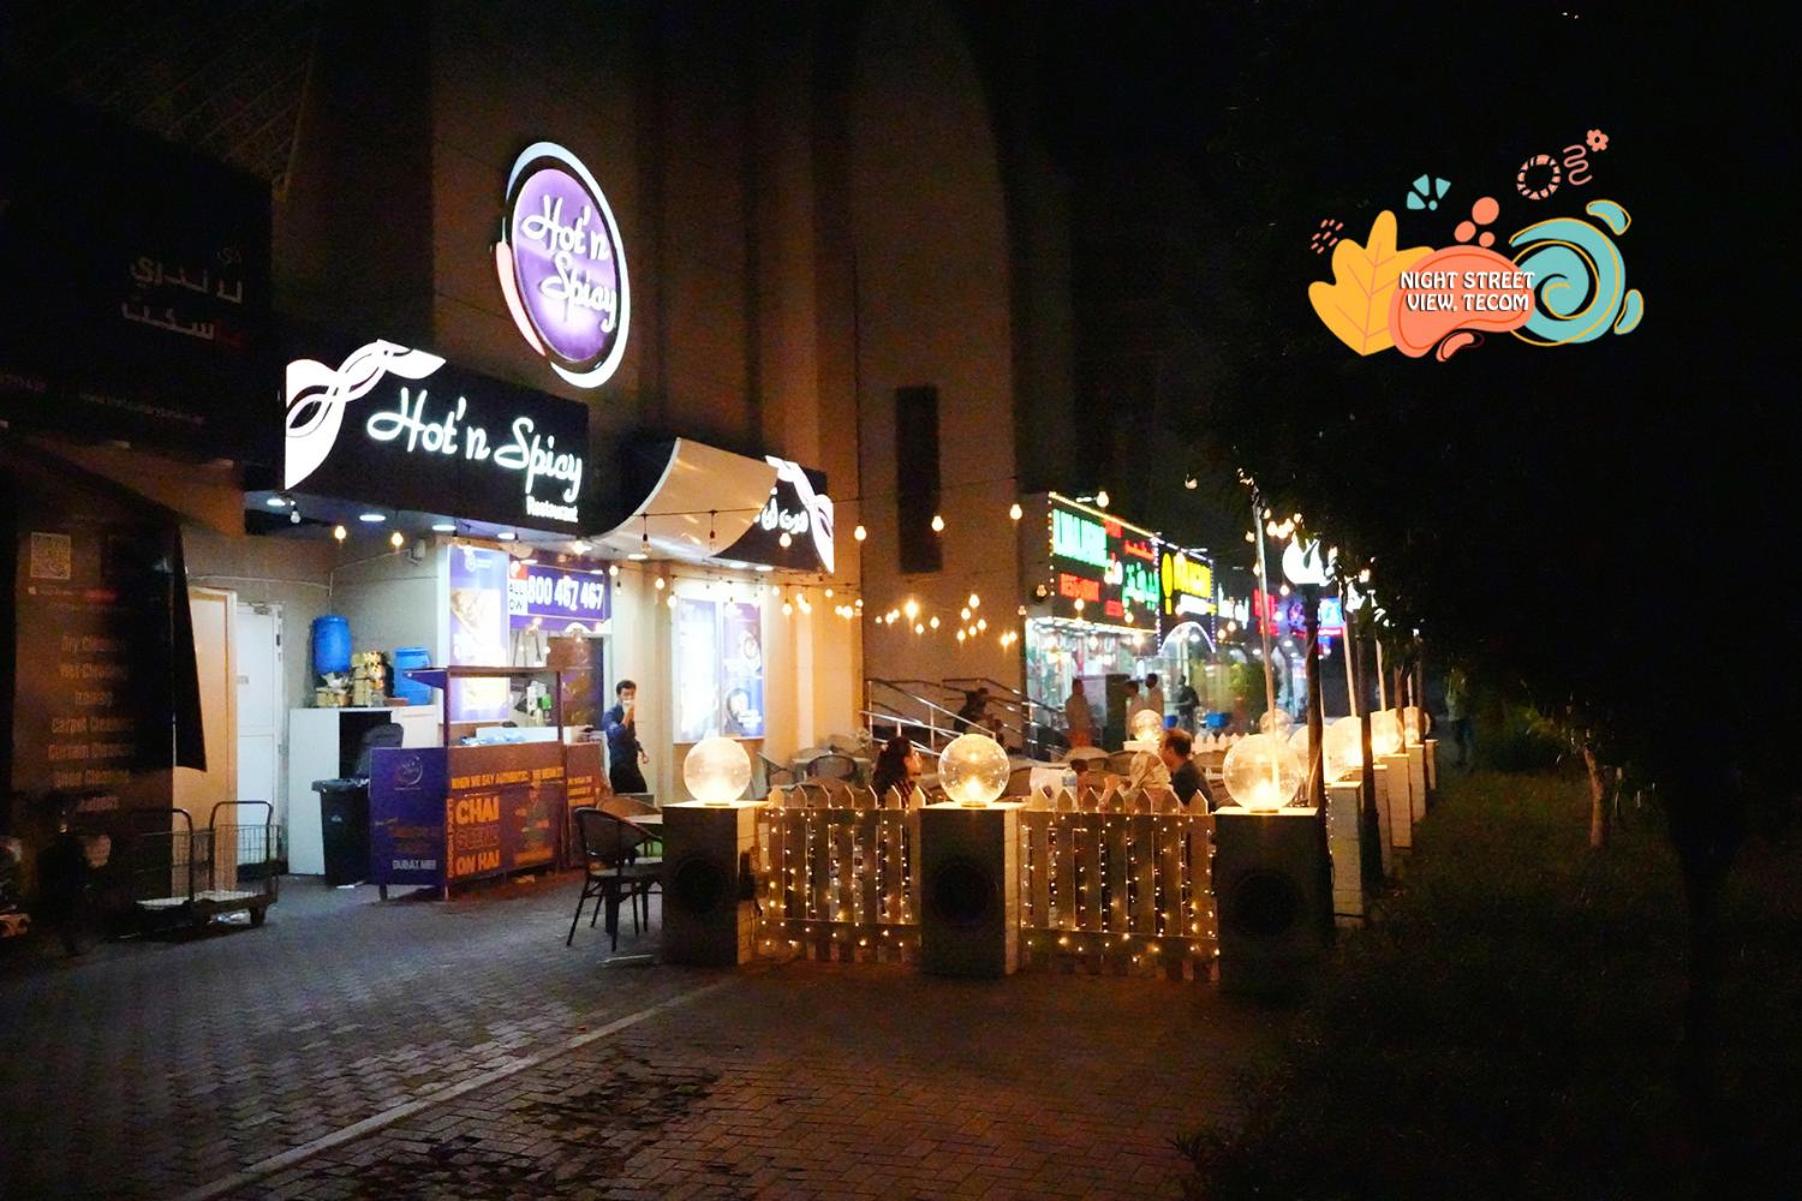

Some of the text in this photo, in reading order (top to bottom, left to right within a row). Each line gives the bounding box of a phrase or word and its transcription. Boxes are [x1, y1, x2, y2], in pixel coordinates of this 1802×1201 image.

[537, 251, 617, 334] Spicy
[494, 416, 584, 503] Spicy
[455, 796, 500, 825] CHAI
[455, 855, 477, 876] ON
[478, 849, 501, 871] HAI
